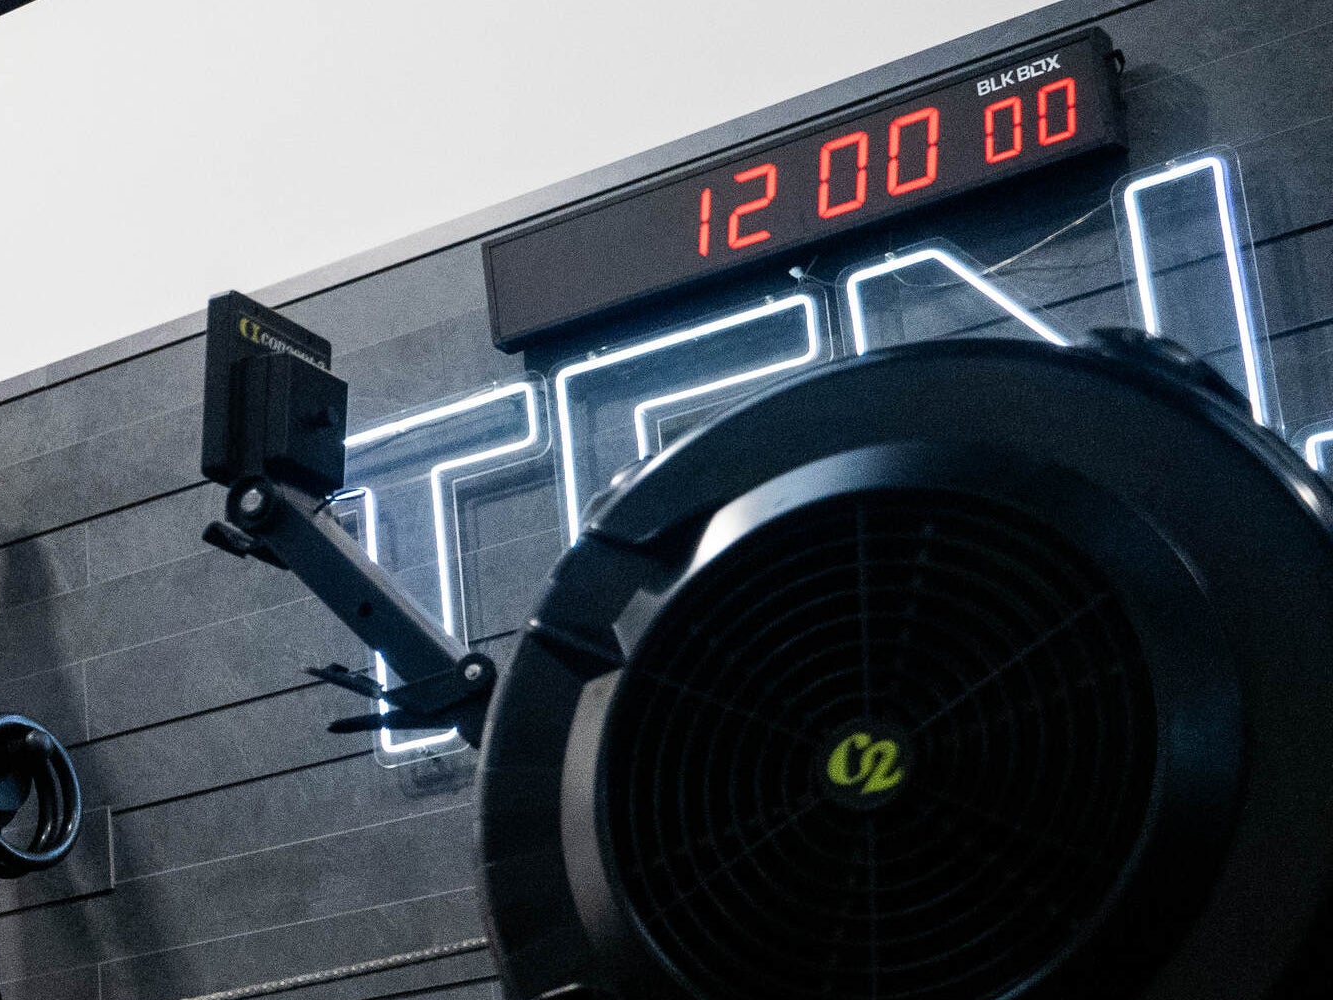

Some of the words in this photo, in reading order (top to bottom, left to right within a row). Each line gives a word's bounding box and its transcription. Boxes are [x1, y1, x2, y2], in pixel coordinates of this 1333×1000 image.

[976, 70, 1015, 96] BLK
[1016, 54, 1061, 82] BOX
[698, 163, 777, 257] 12
[818, 106, 939, 219] 00
[984, 76, 1076, 164] 00
